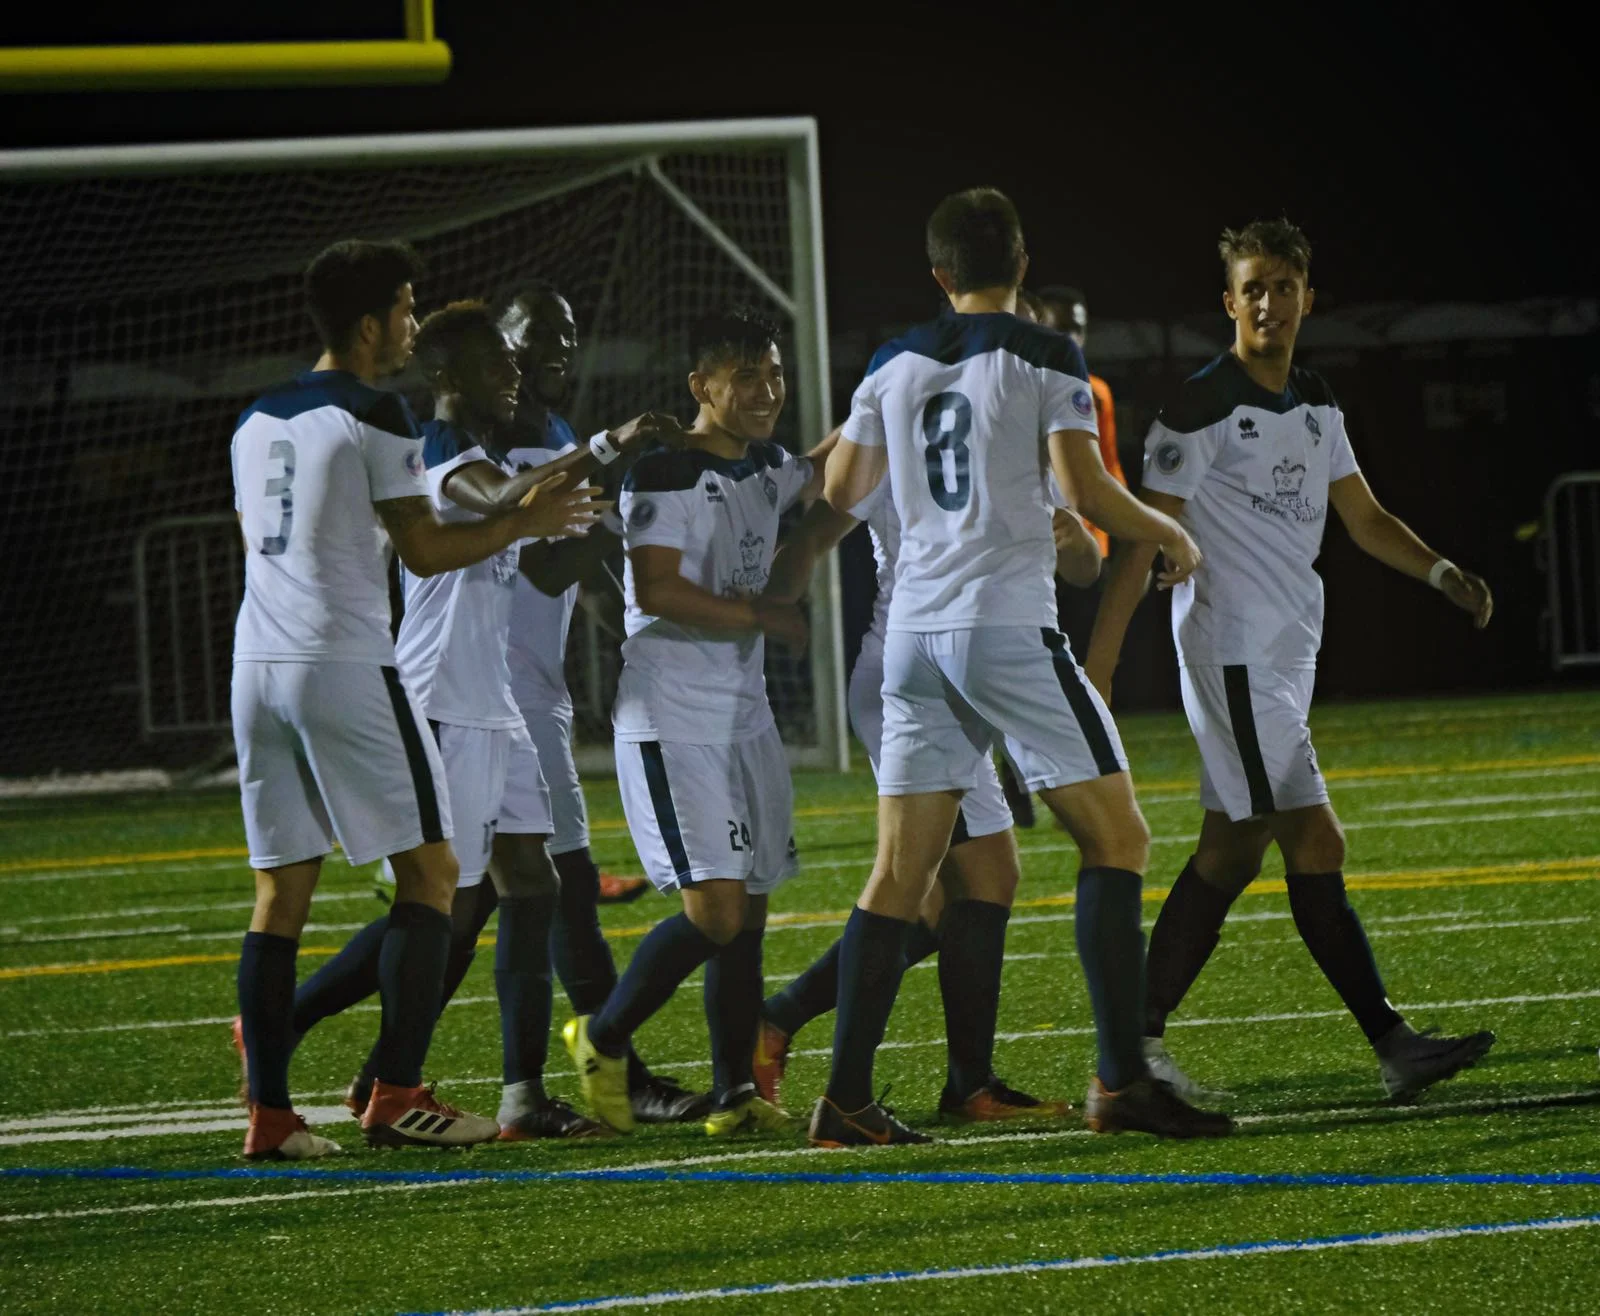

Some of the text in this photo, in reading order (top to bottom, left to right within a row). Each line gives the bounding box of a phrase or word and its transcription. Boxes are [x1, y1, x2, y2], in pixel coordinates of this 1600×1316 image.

[260, 440, 296, 556] 3
[922, 391, 973, 512] 8
[727, 820, 753, 851] 24
